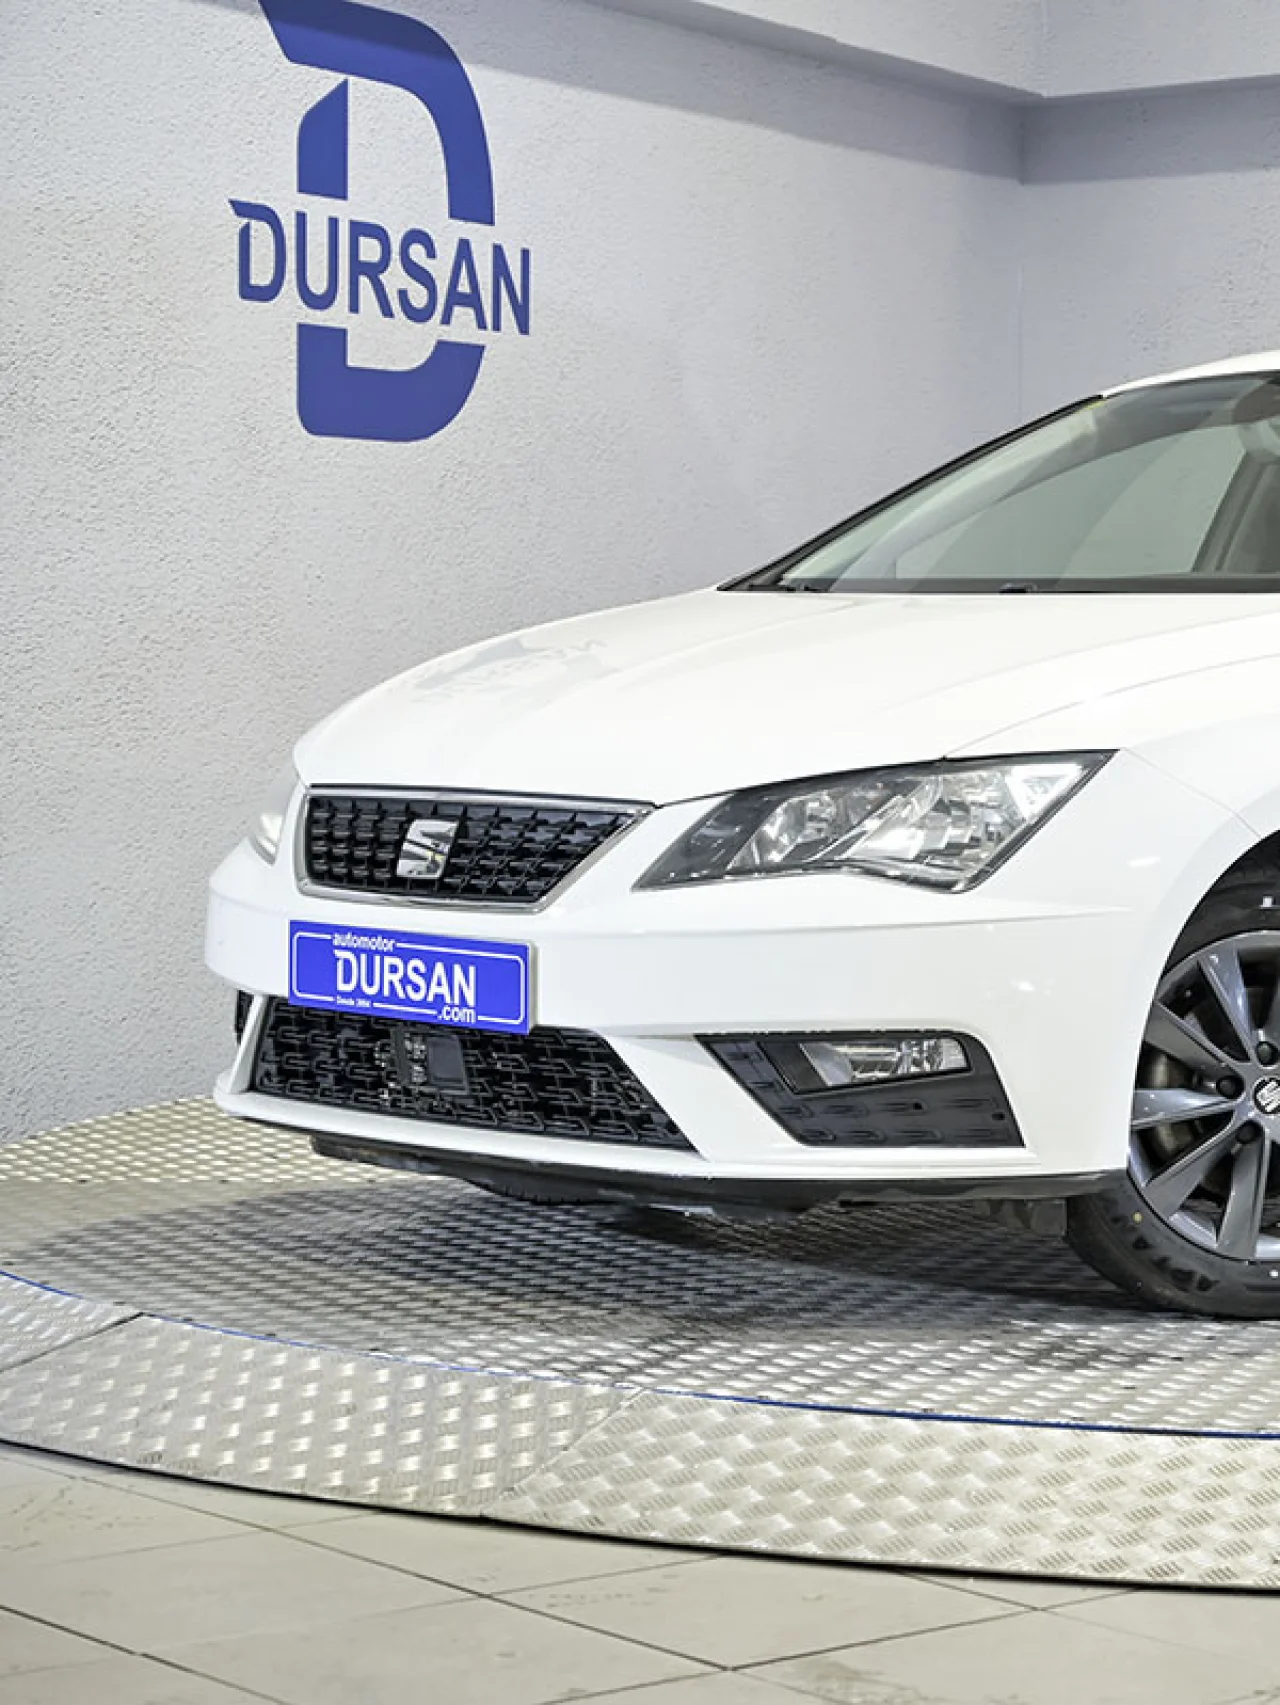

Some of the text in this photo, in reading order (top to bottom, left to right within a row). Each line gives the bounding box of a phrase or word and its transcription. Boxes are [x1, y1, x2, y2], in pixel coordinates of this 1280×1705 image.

[228, 199, 530, 336] DURSAN
[332, 932, 395, 951] automotor
[333, 949, 477, 1007] DURSAN
[437, 1004, 477, 1023] .com
